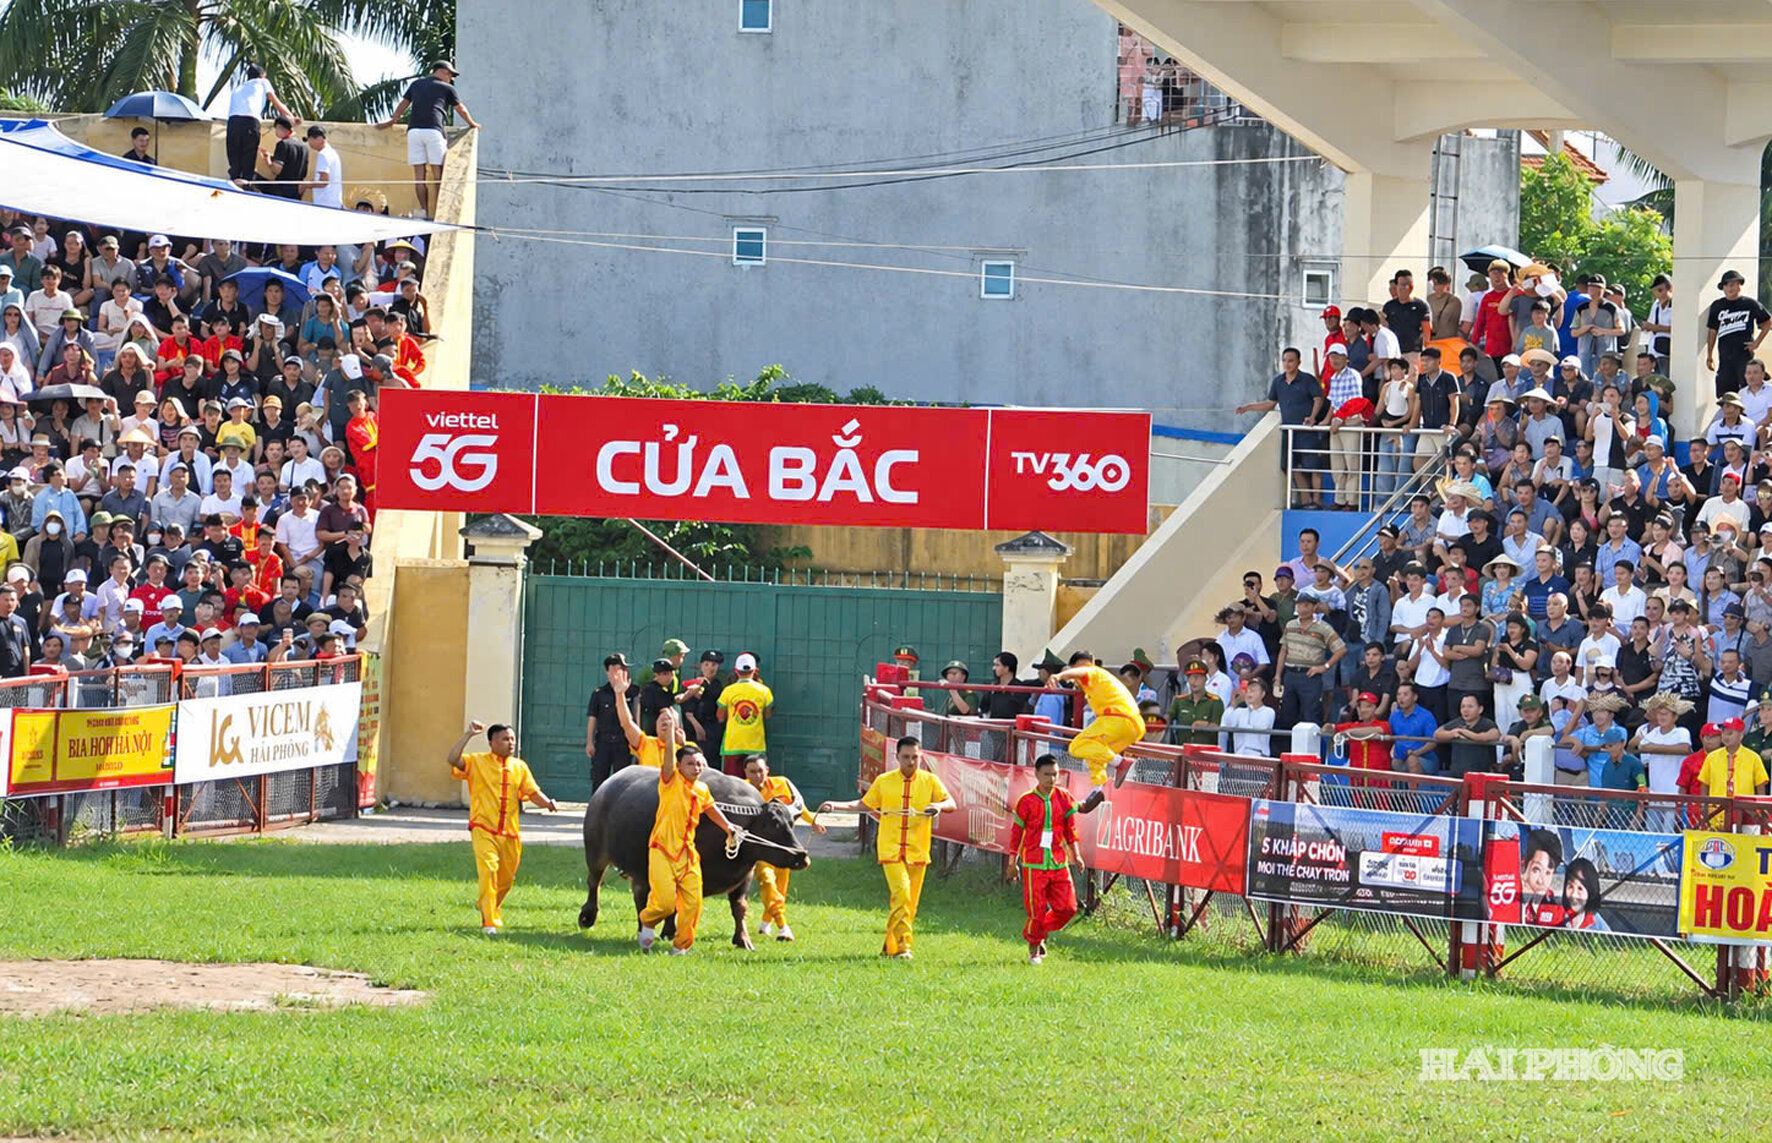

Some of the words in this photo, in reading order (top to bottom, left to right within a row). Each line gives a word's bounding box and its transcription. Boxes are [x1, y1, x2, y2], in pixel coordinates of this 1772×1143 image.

[426, 412, 499, 430] viettel
[409, 433, 499, 492] 5G
[596, 423, 751, 499] CỬA
[768, 418, 920, 504] BẮC
[1011, 451, 1131, 493] TV360
[247, 701, 311, 738] VICEM
[68, 738, 87, 758] BIA
[1111, 815, 1204, 864] AGRIBANK
[1490, 881, 1516, 905] 5G
